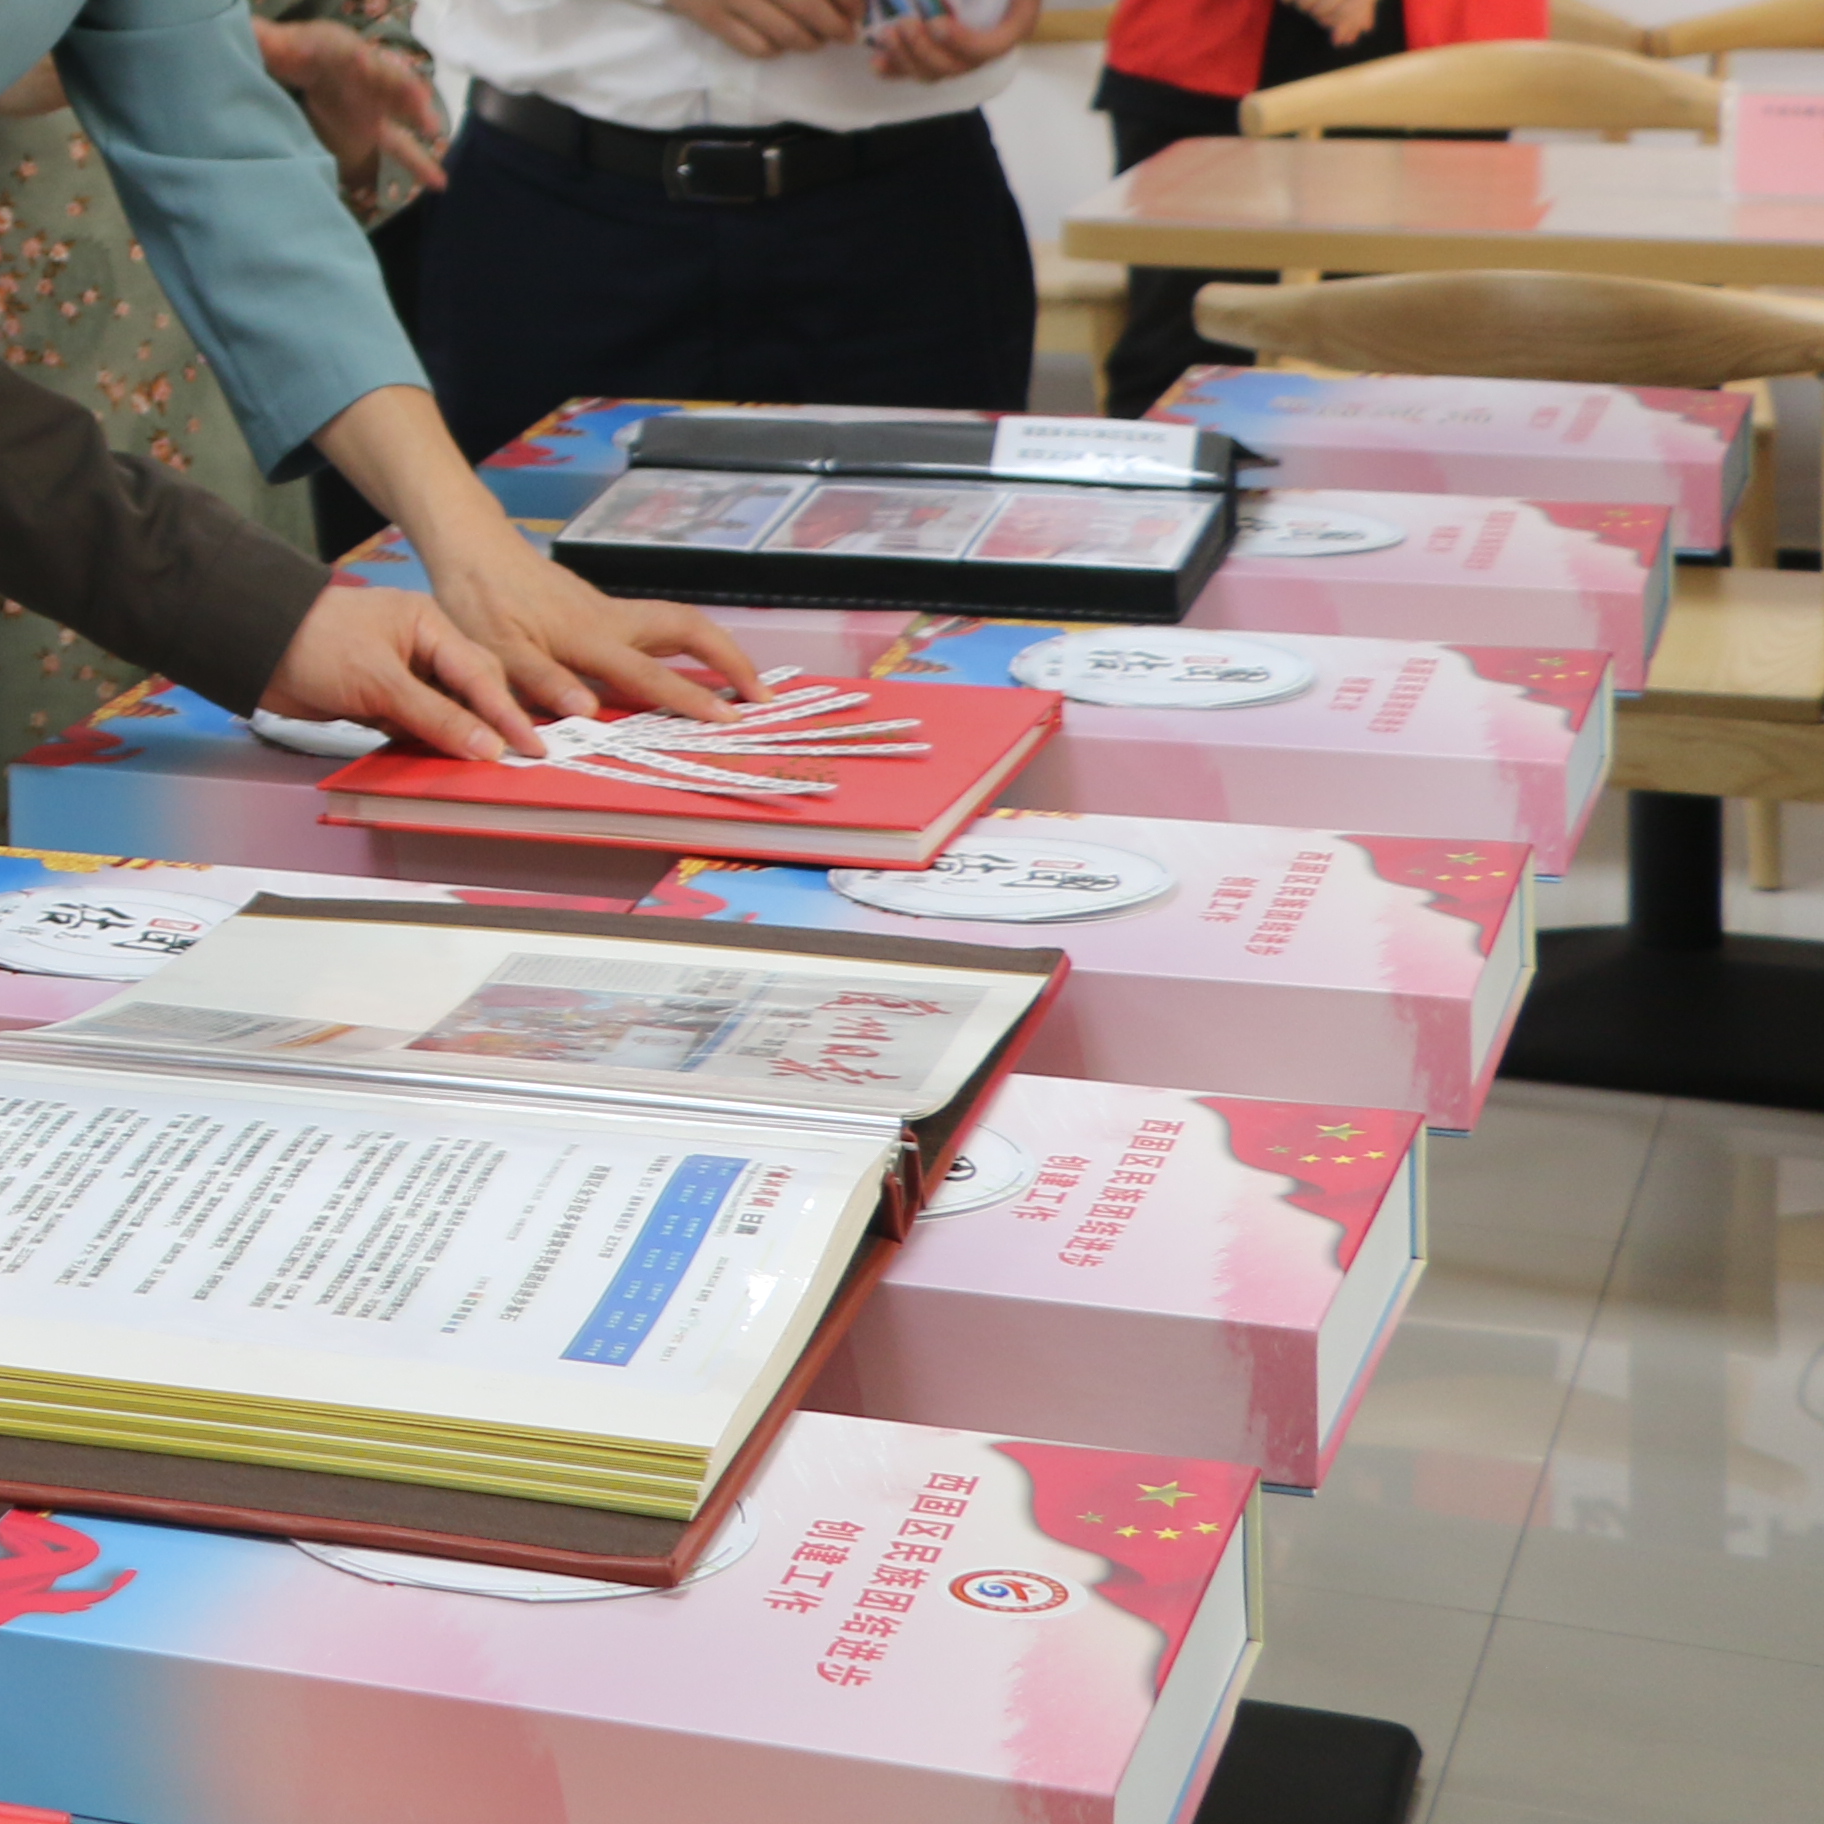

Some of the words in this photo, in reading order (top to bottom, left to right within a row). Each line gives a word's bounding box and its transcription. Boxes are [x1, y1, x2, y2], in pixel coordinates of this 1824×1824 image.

[1009, 1152, 1092, 1223] 创建工作
[1056, 1117, 1186, 1269] 西固区民族团结进步
[762, 1518, 867, 1614] 创建工作
[815, 1471, 981, 1687] 西固区民族团结进步
